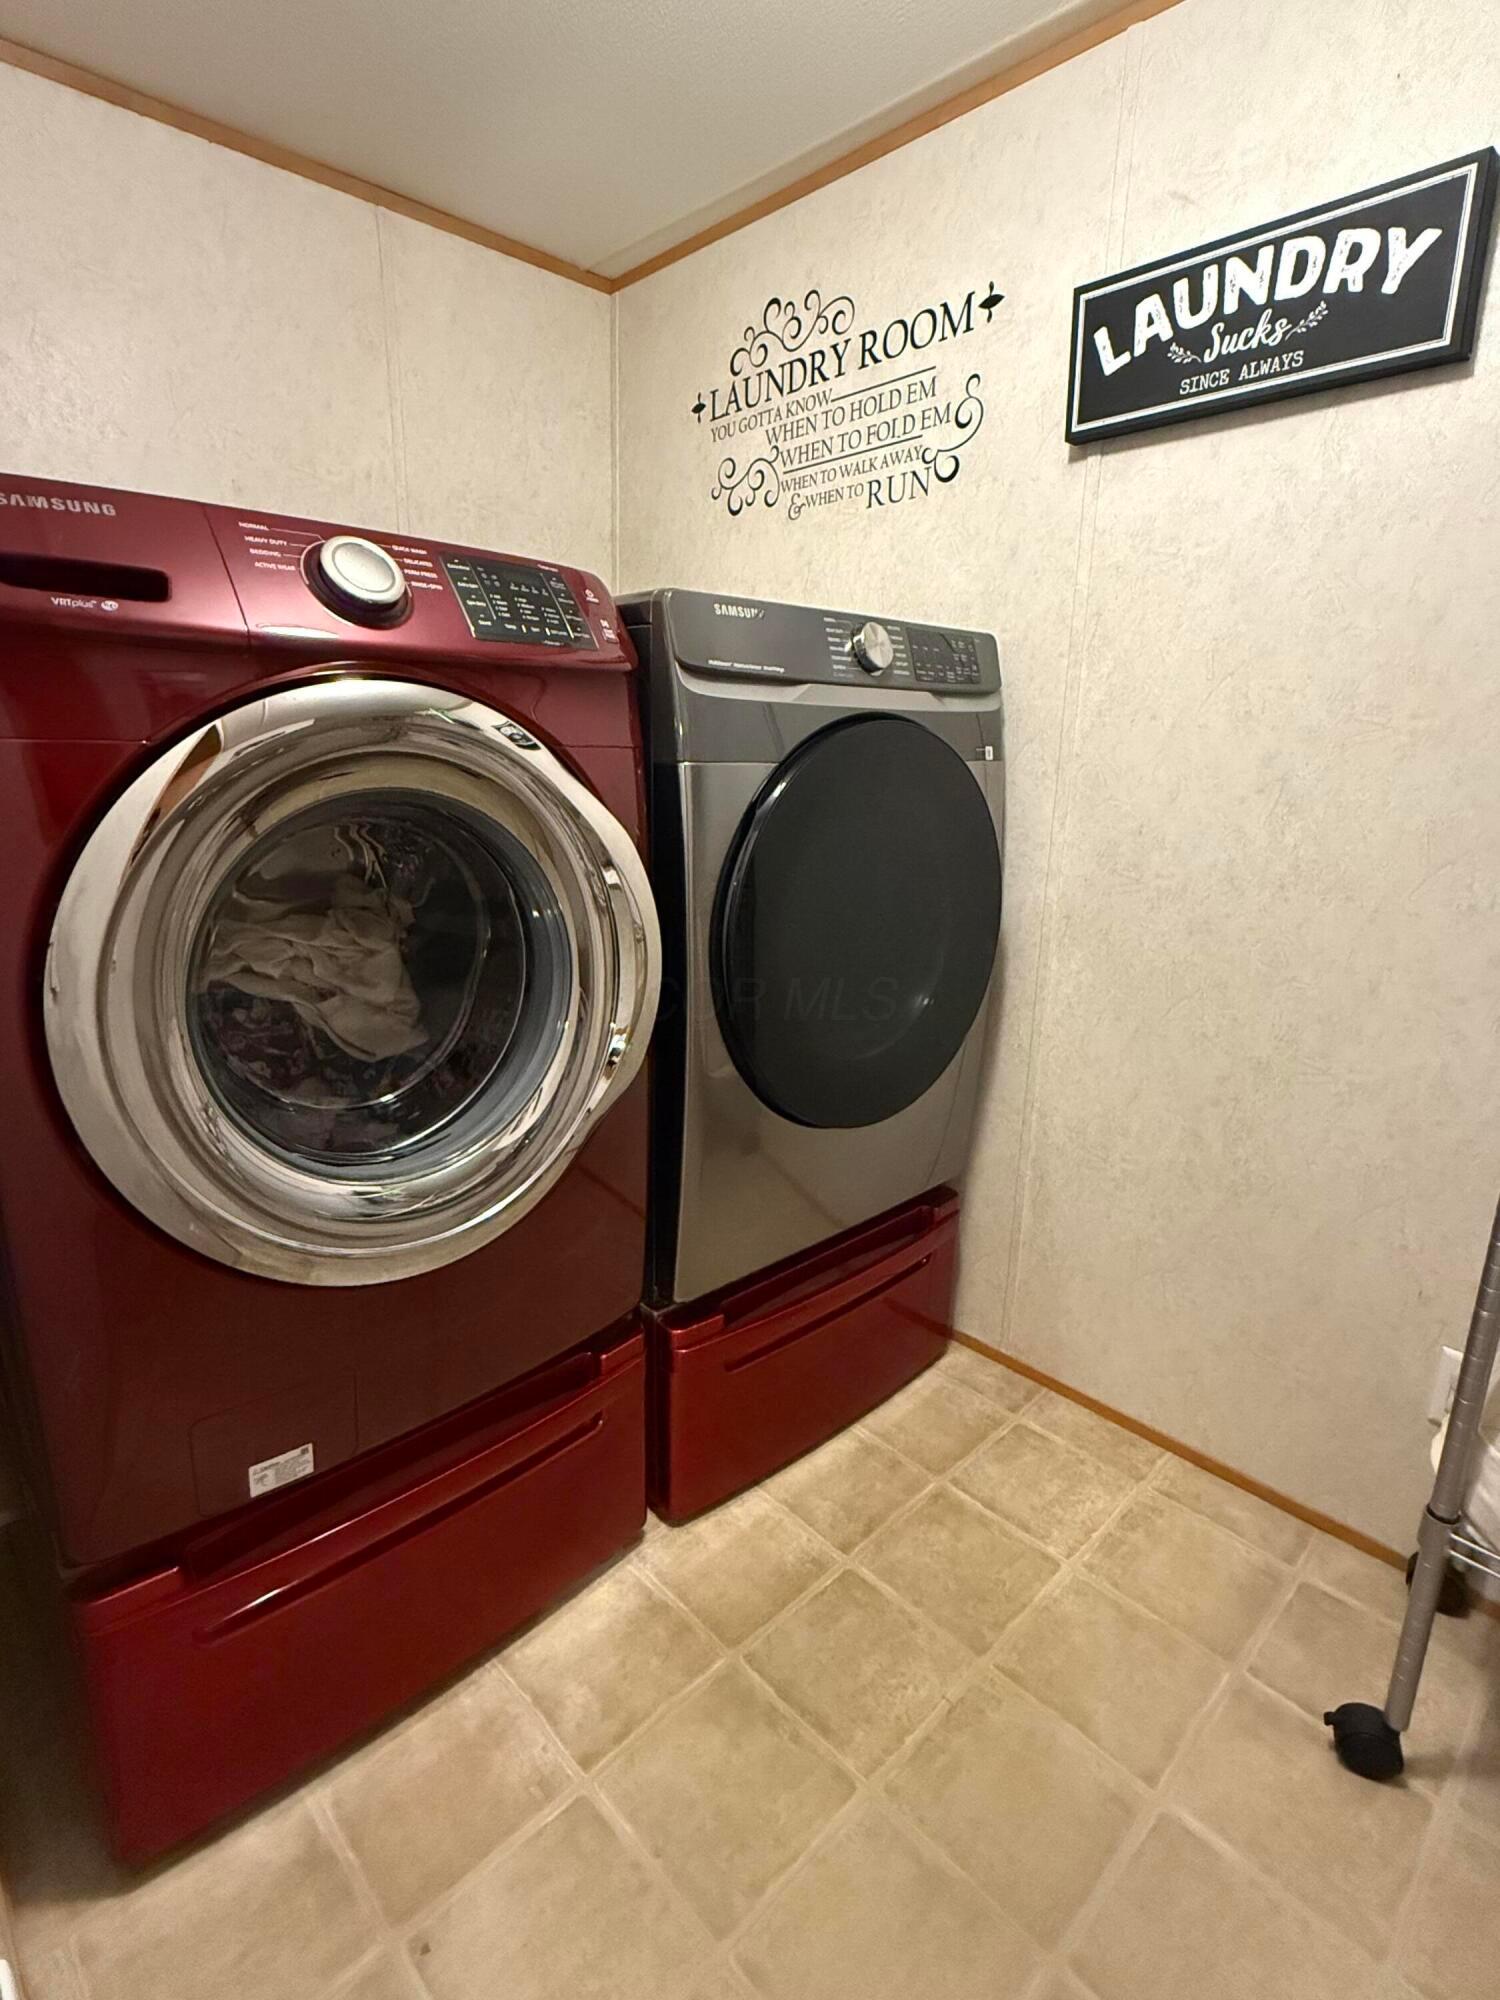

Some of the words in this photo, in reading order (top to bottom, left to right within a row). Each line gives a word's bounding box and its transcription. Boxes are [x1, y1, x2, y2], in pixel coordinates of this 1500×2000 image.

[1093, 227, 1442, 376] LAUNDRY
[709, 339, 851, 422] LAUNDRY
[858, 291, 976, 370] ROOM
[1203, 308, 1294, 364] Sucks
[1179, 368, 1230, 395] SINCE
[1239, 350, 1304, 382] ALWAYS
[711, 421, 736, 442] YOU
[738, 406, 783, 433] GOTTA
[786, 388, 832, 418] KNOW
[765, 414, 818, 445] WHEN
[821, 406, 846, 430] TO
[850, 388, 901, 422] HOLD
[906, 375, 937, 404] EM
[780, 436, 834, 468] WHEN
[837, 430, 862, 452] TO
[867, 414, 916, 445] FOLD
[920, 402, 952, 430] EM
[781, 471, 818, 493] WHEN
[820, 468, 837, 483] TO
[839, 456, 878, 479] WALK
[880, 445, 923, 469] AWAY
[846, 483, 864, 499] TO
[866, 466, 932, 509] RUN
